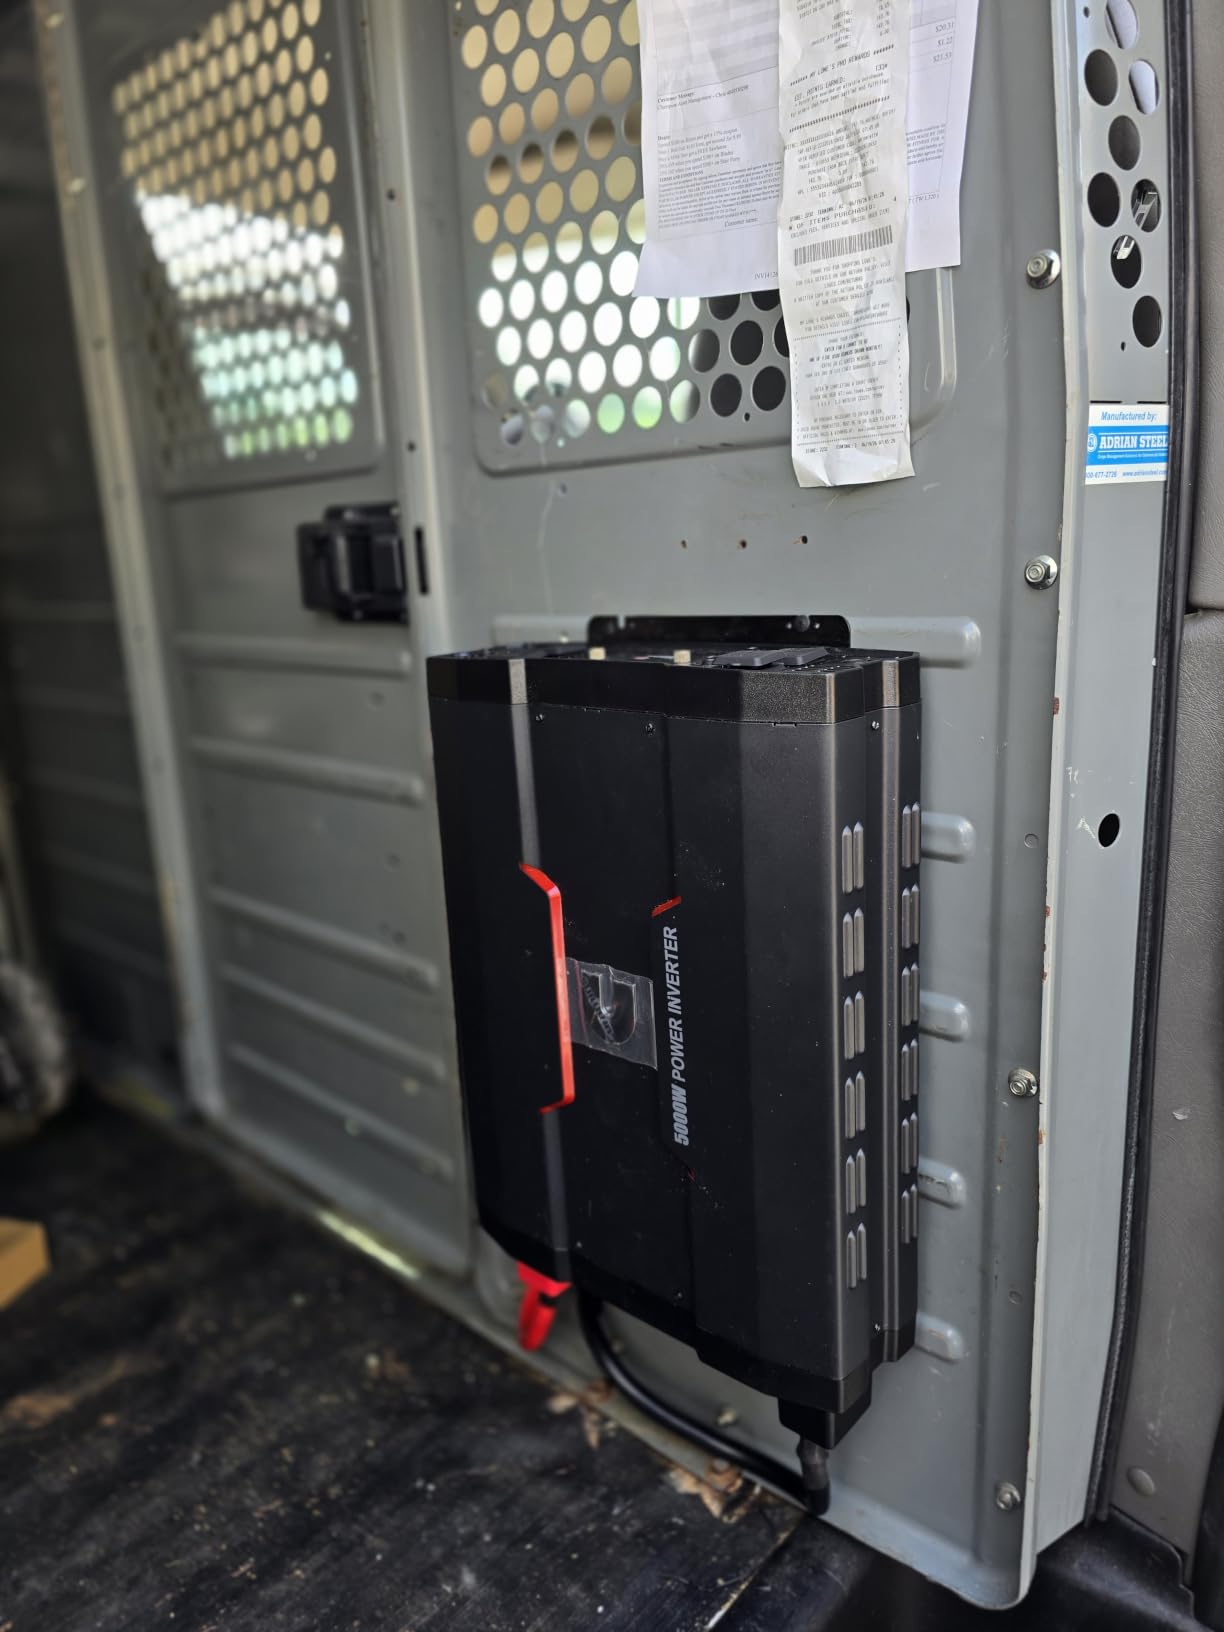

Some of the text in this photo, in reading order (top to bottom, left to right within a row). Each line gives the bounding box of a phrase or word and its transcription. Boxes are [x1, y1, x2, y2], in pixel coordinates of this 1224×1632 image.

[1101, 411, 1157, 422] Manufactured by:
[1099, 434, 1168, 449] ADRIAN STEEL
[663, 925, 690, 1146] 5000W POWER INVERTER
